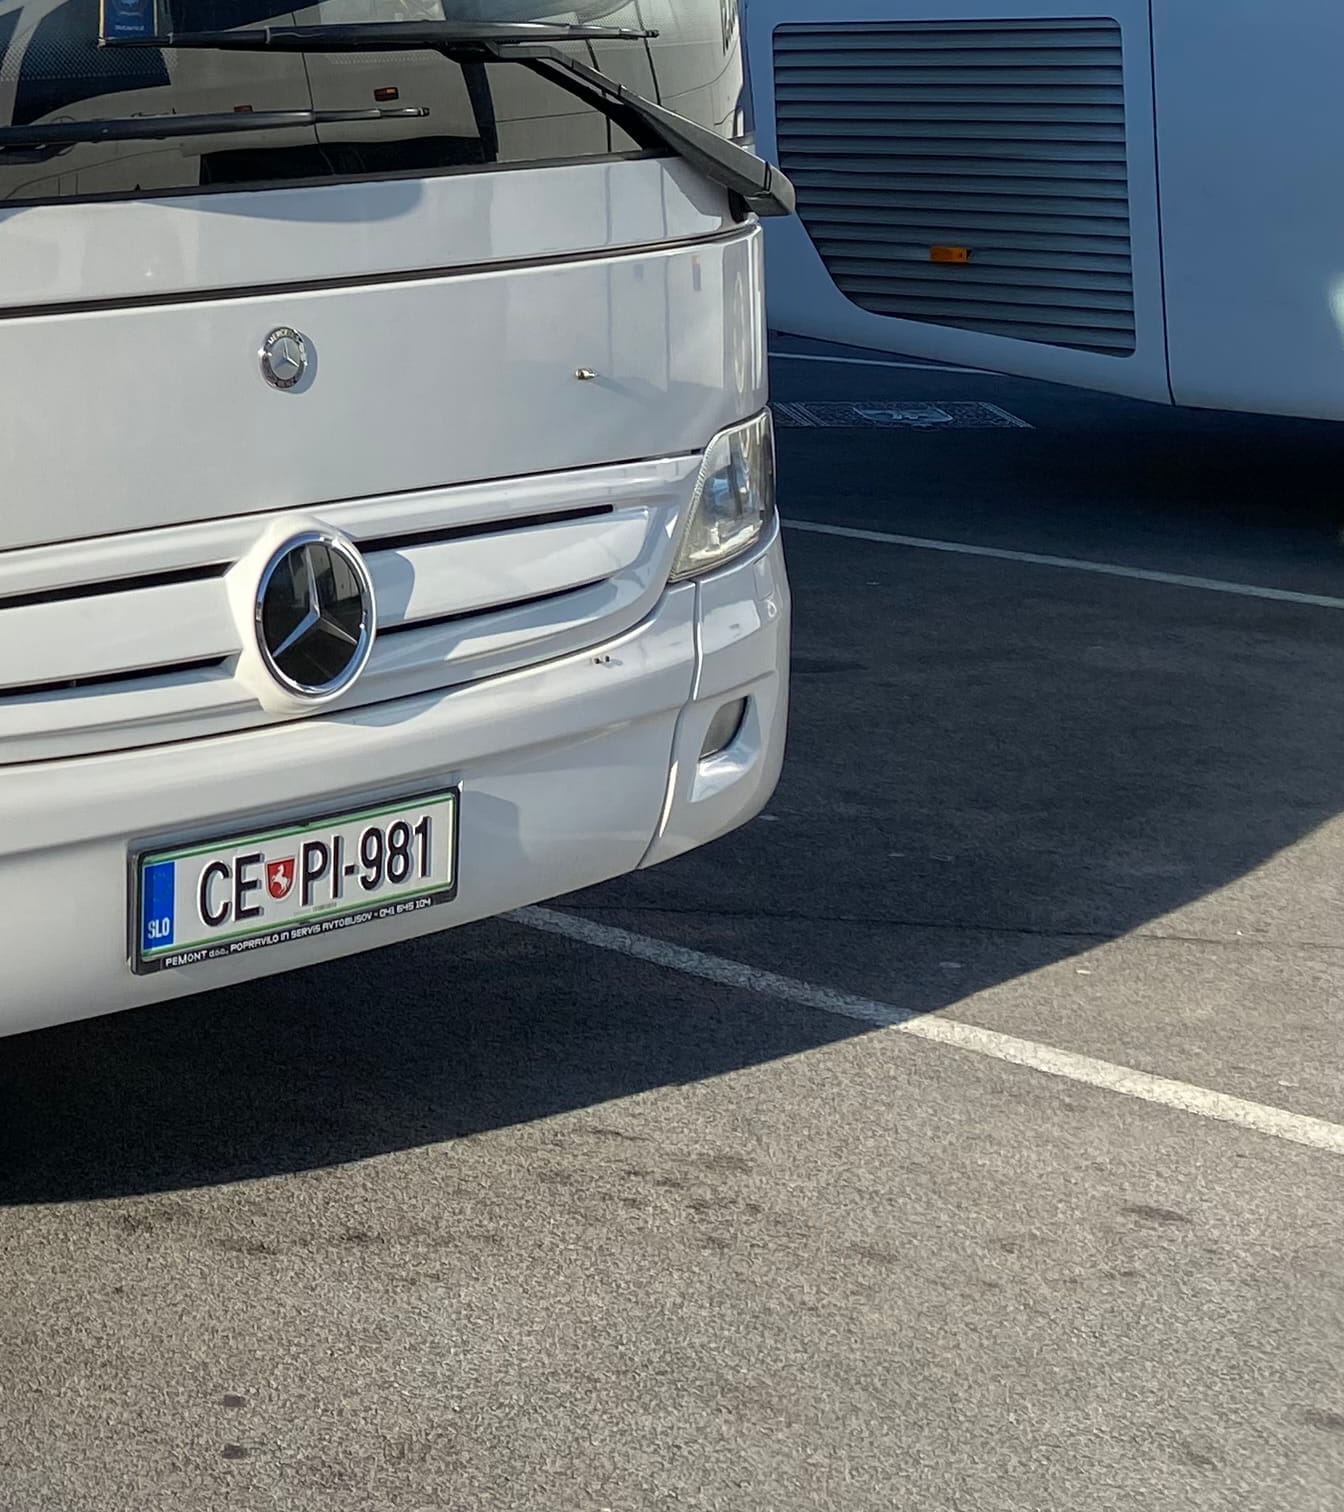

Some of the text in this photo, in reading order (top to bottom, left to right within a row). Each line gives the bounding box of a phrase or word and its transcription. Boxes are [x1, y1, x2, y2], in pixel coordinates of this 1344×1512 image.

[197, 814, 433, 928] CE PI-981
[147, 916, 170, 939] SLO
[230, 933, 280, 952] POPRAVILO
[290, 924, 322, 939] SERVIS
[322, 911, 373, 931] AVTOBUSOV
